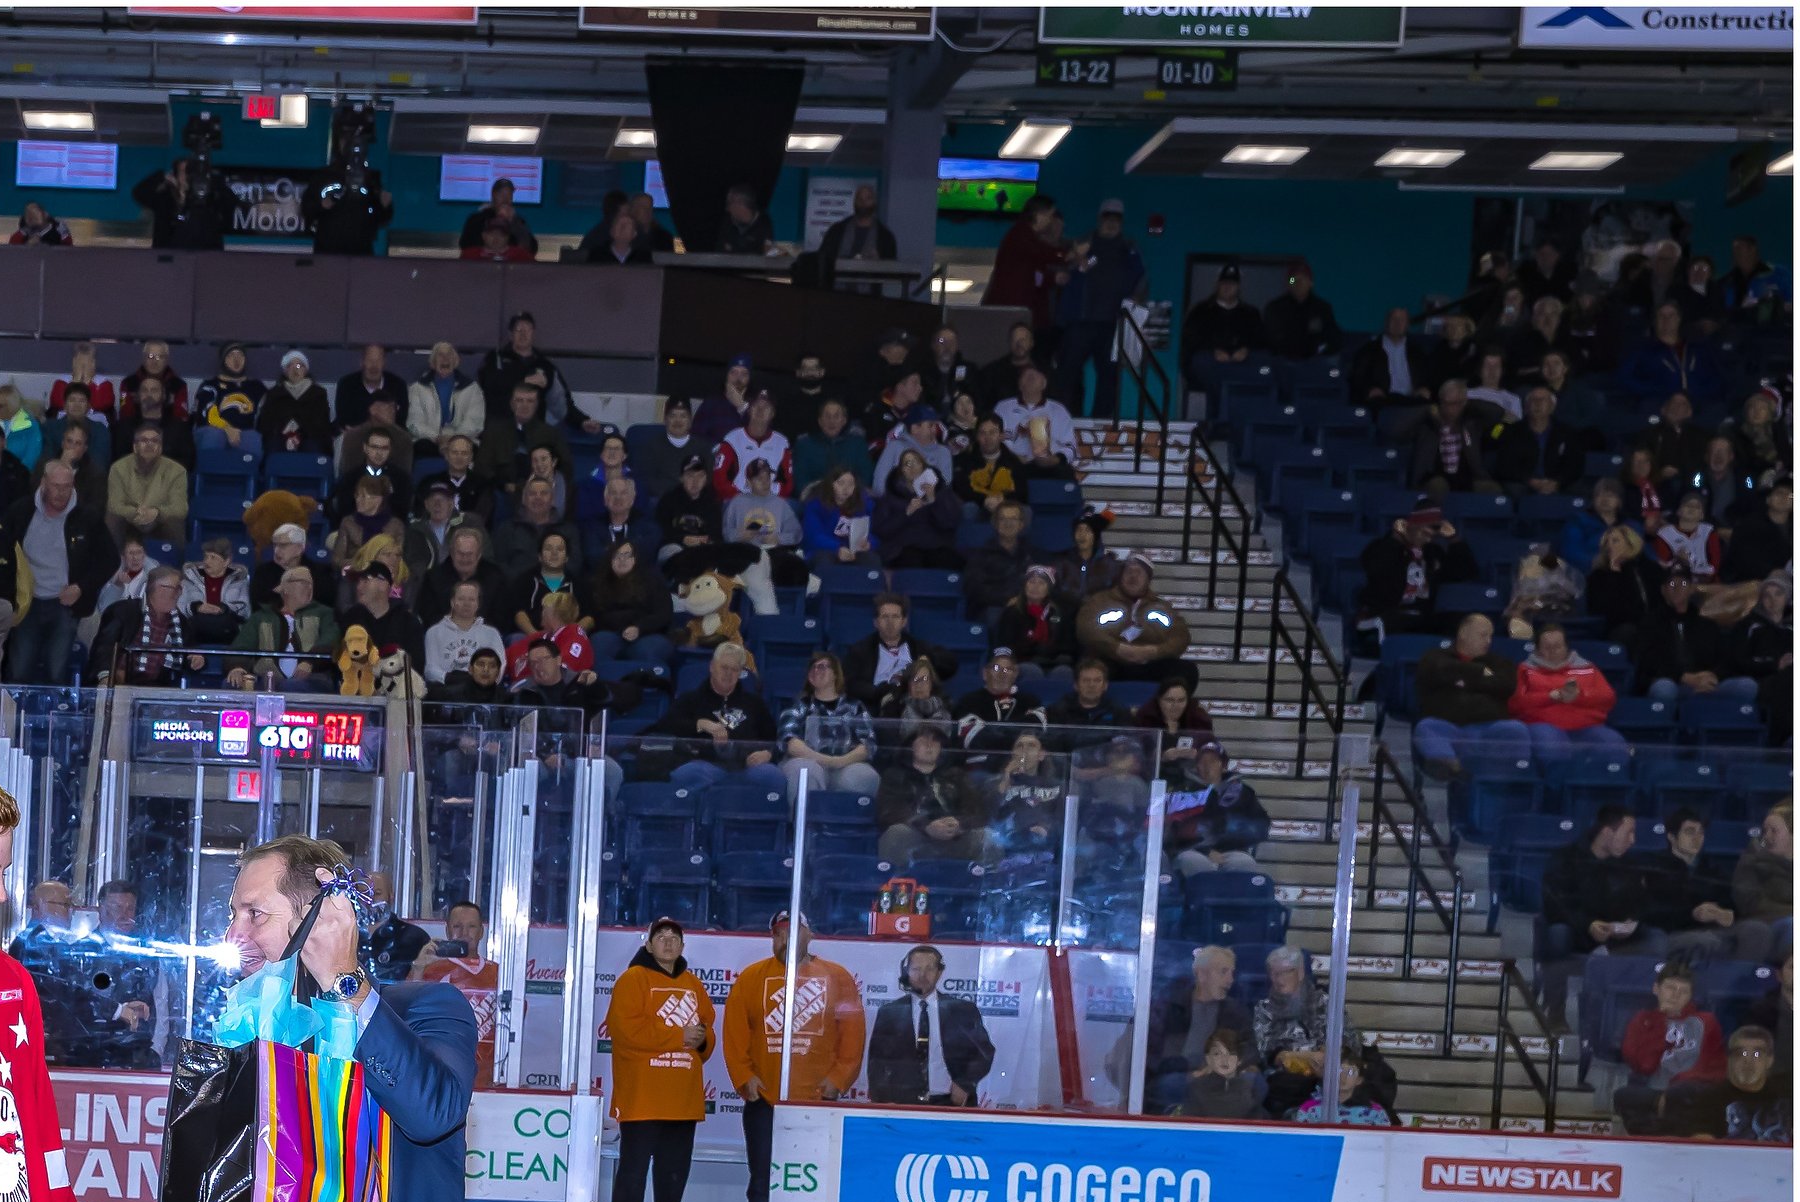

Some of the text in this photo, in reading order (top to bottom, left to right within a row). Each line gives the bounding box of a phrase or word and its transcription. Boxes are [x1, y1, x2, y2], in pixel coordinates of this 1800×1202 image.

[1180, 24, 1250, 37] HOMES
[1059, 60, 1111, 83] 13-22
[1162, 63, 1214, 85] 01-10
[259, 726, 312, 750] 610
[513, 1107, 570, 1139] CO
[465, 1149, 569, 1183] CLEAN
[1431, 1163, 1615, 1193] NEWSTALK
